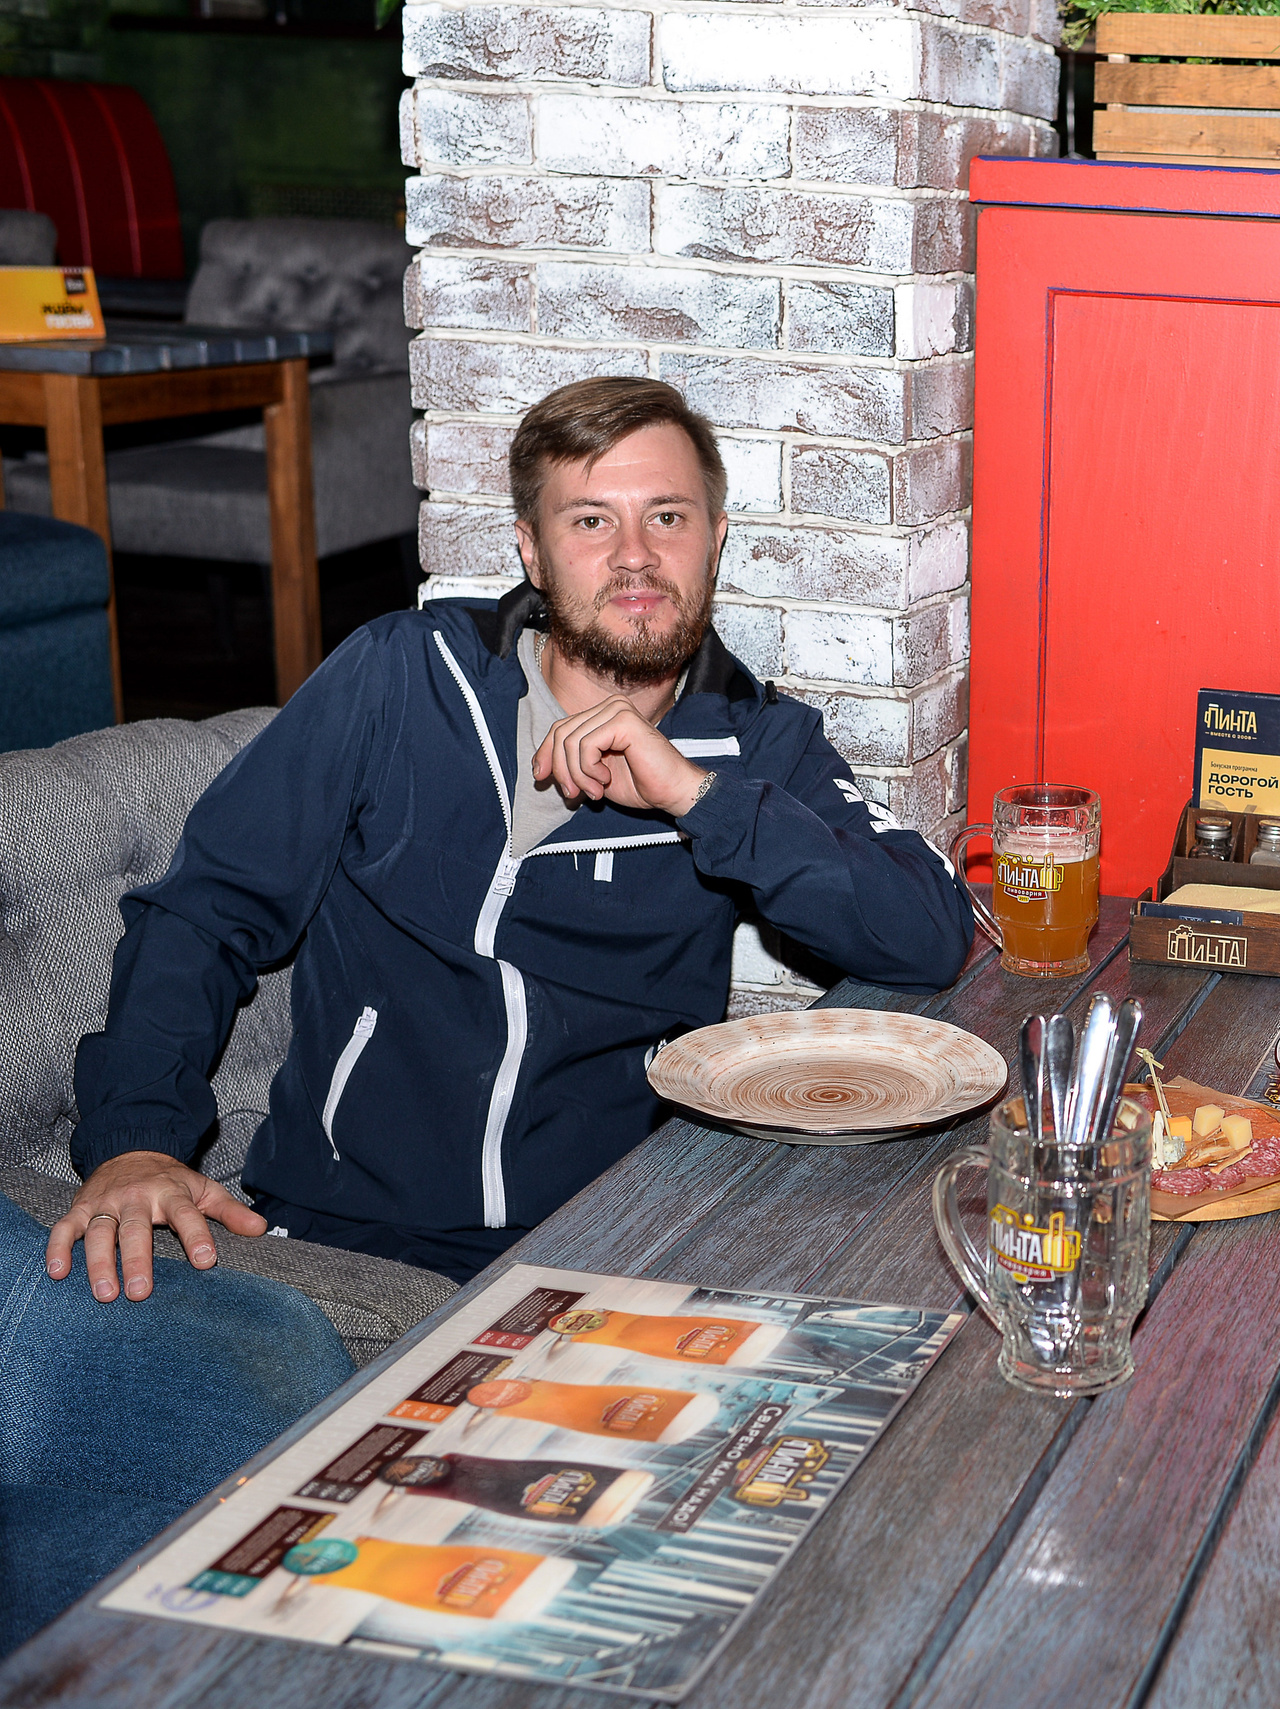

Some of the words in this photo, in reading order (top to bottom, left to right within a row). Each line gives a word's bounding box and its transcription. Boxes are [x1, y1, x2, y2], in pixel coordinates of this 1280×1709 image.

[1204, 703, 1258, 734] ПИНТА
[1208, 772, 1279, 788] ДОРОГОЙ
[1208, 784, 1254, 798] ГОСТЬ
[998, 863, 1040, 889] ПИНТА
[1007, 887, 1042, 897] пивоварня
[1170, 935, 1242, 966] ПИНТА
[989, 1219, 1042, 1264] ПИНТА
[751, 1438, 817, 1485] ПИНТА
